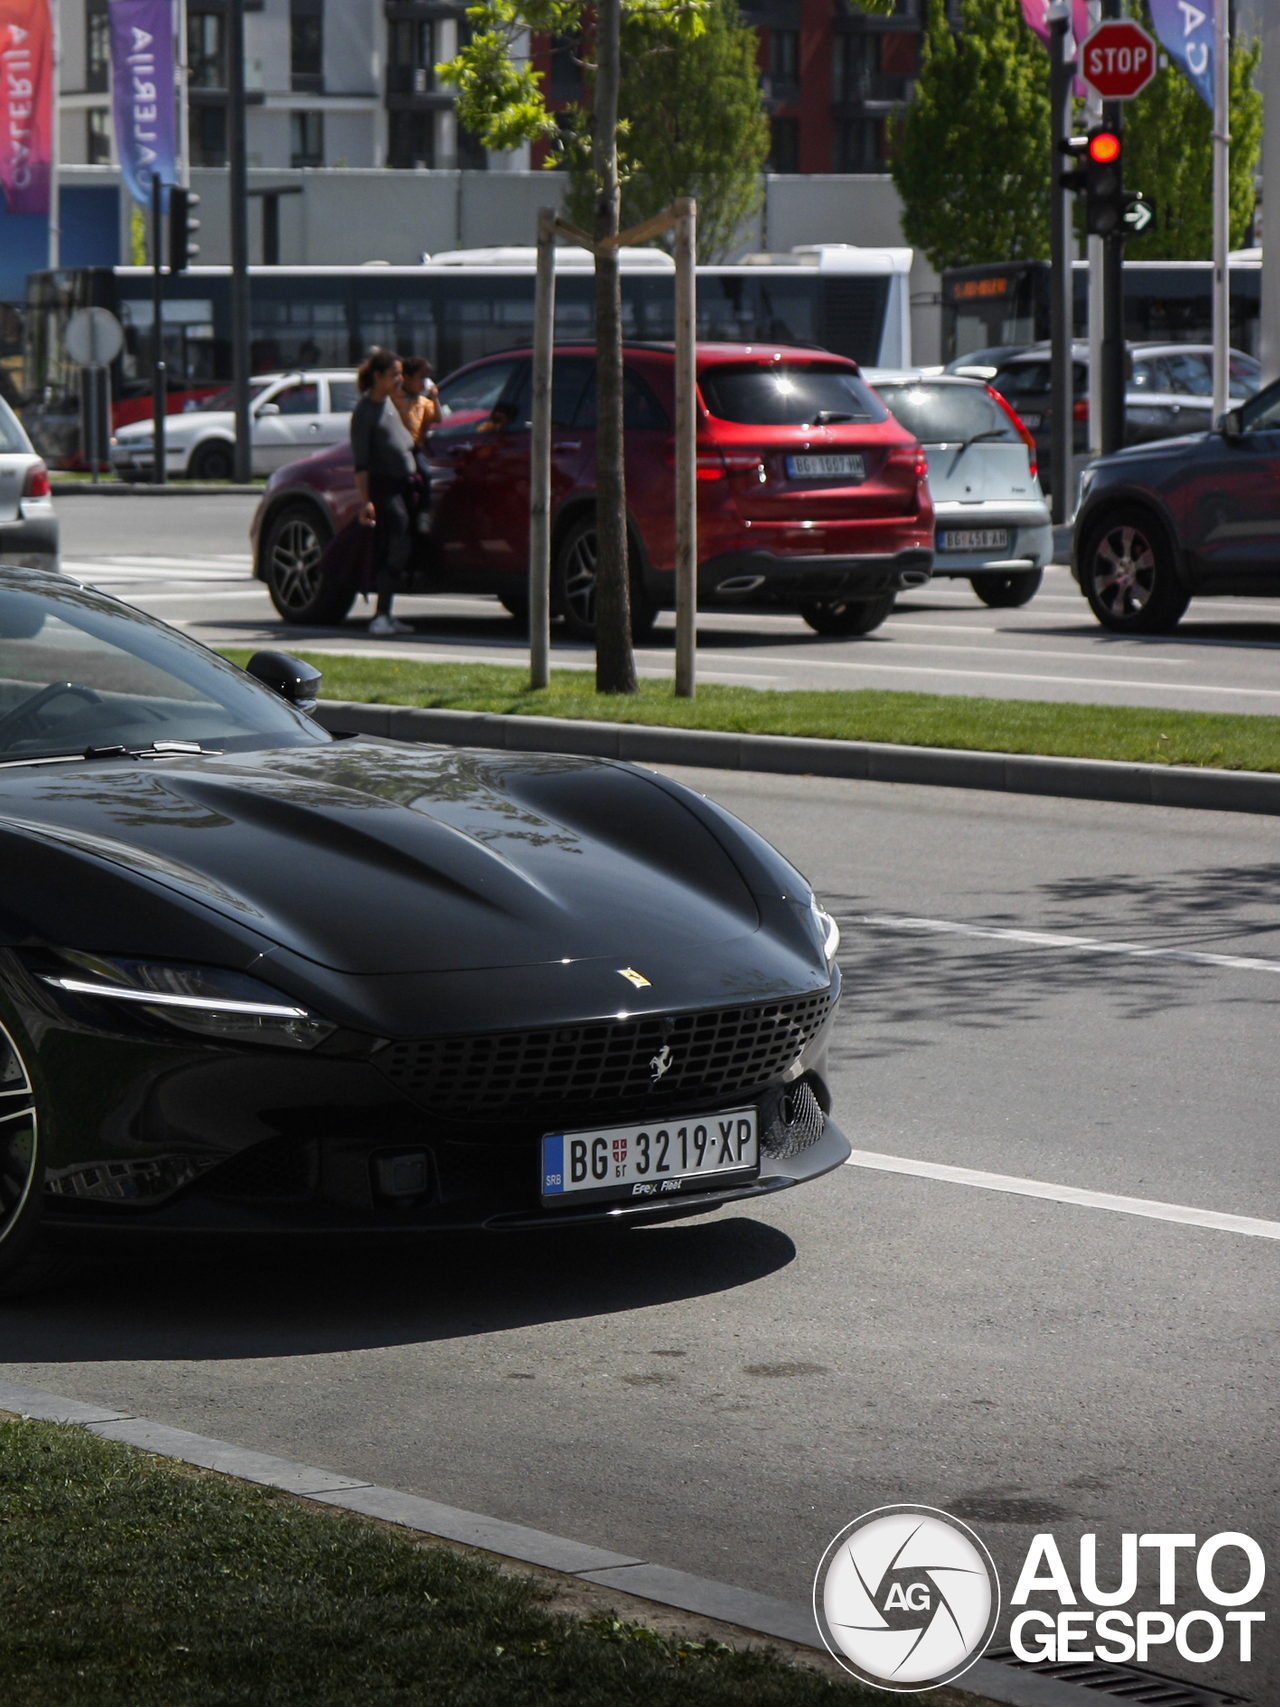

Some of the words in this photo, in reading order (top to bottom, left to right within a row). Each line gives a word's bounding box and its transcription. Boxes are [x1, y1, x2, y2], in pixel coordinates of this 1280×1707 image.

[1090, 46, 1147, 74] STOP
[571, 1137, 608, 1183] BG
[546, 1174, 562, 1186] SRB
